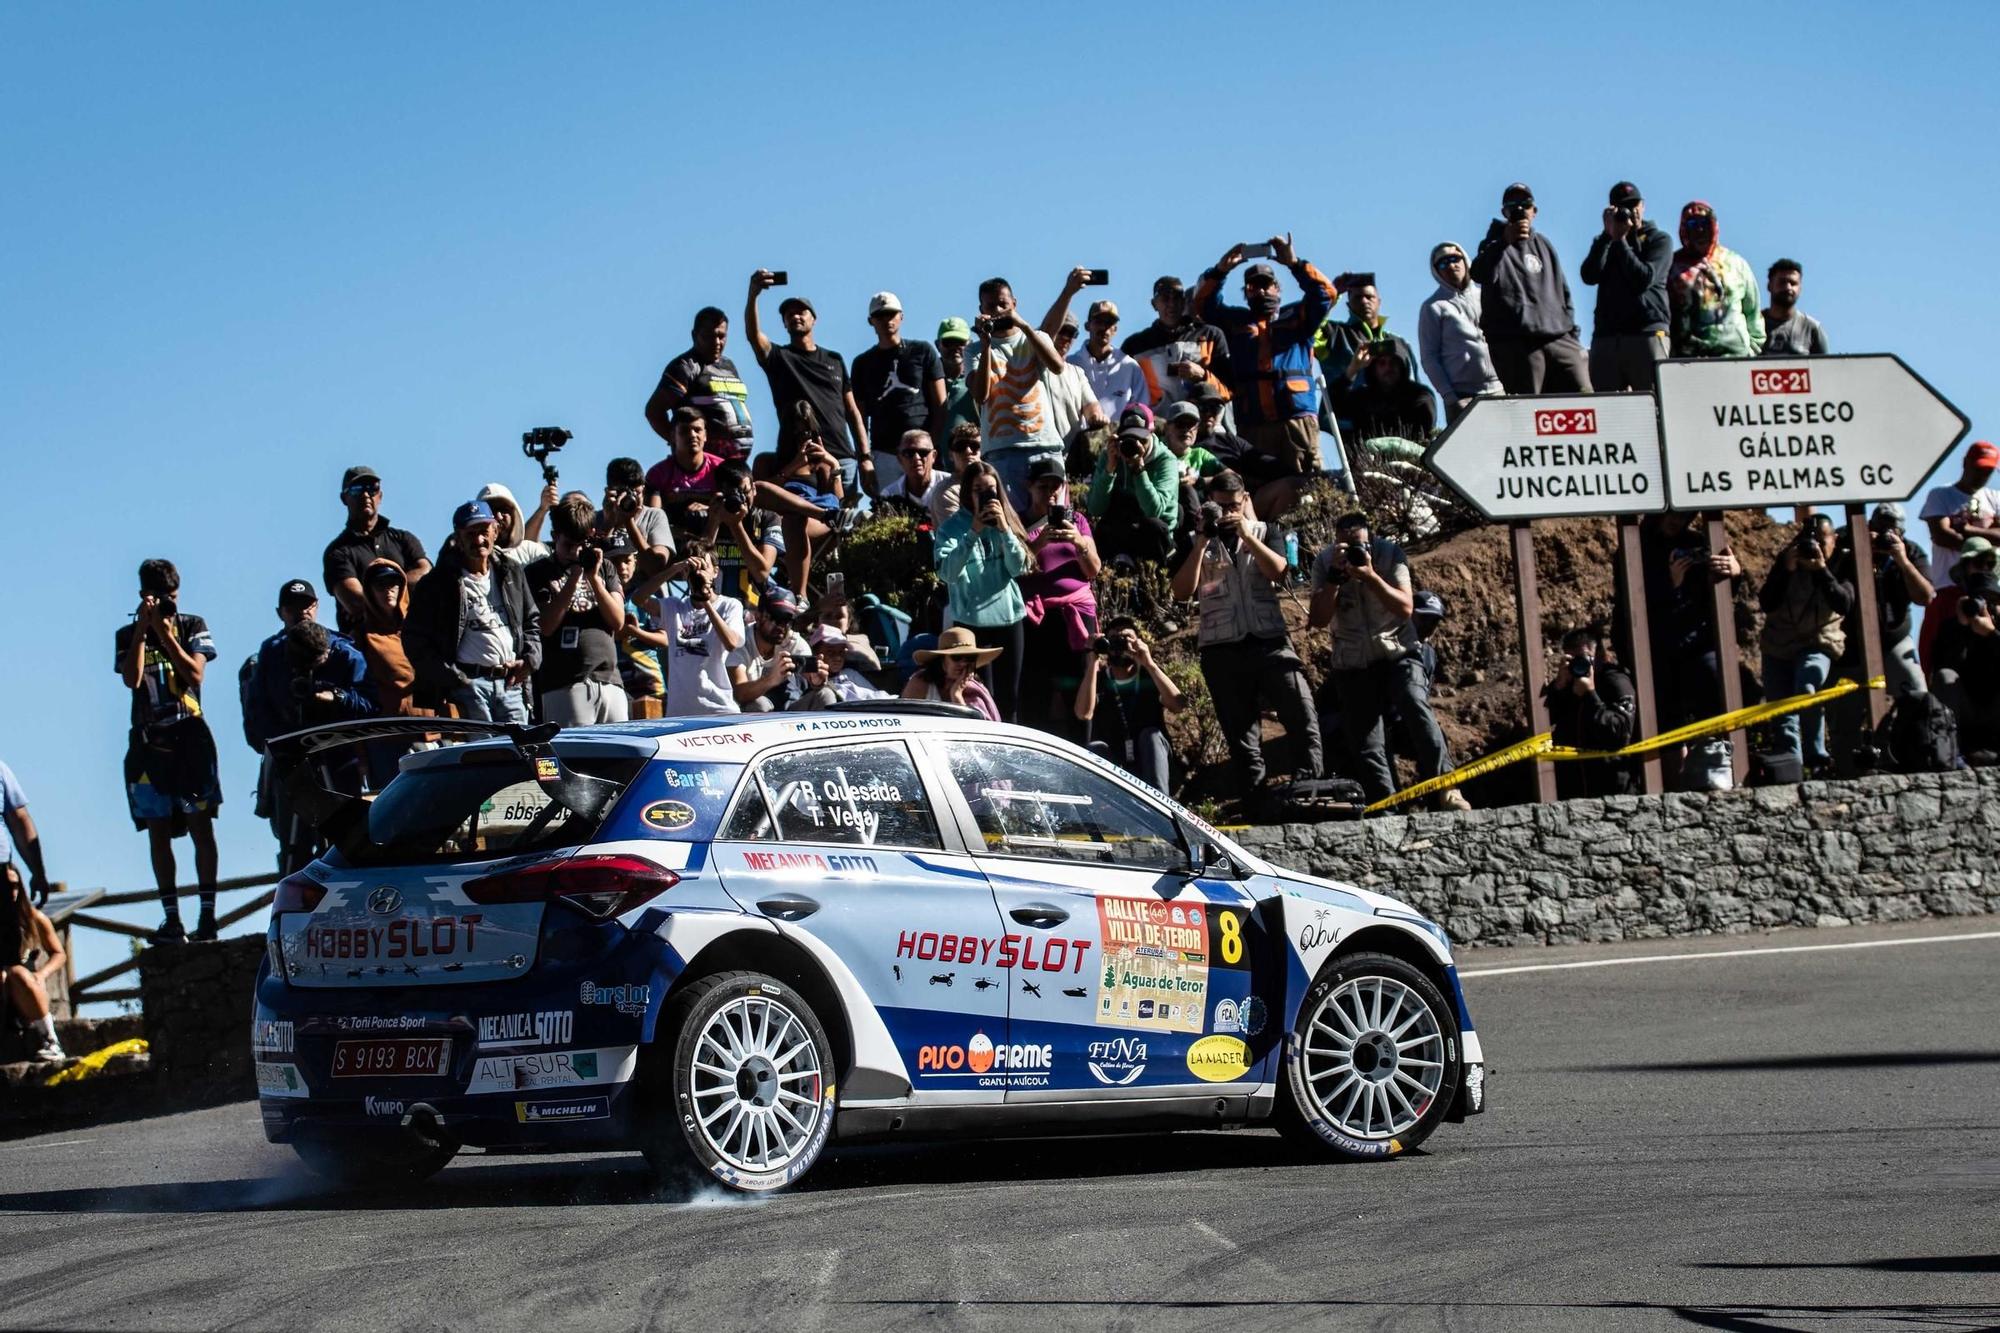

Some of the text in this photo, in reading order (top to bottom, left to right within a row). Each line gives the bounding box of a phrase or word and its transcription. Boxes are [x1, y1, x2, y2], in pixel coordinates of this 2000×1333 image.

[1753, 370, 1809, 394] GC-21
[1537, 411, 1595, 434] GC-21
[1713, 401, 1853, 427] VALLESECO
[1502, 442, 1638, 468] ARTENARA
[1739, 431, 1836, 458] GÁLDAR
[1497, 472, 1649, 499] JUNCALILLO
[1686, 464, 1894, 493] LAS PALMAS GC
[821, 720, 857, 730] TODO
[860, 718, 902, 729] MOTOR
[677, 734, 737, 748] VICTOR
[824, 780, 902, 802] Quesada
[807, 805, 874, 833] T. Vega
[743, 852, 829, 872] MECANICA
[1104, 898, 1150, 922] RALLYE
[1108, 920, 1201, 950] VILLA DE TEROR
[1219, 910, 1243, 964] 8
[1122, 971, 1204, 993] Aguas de Teror
[351, 1015, 426, 1030] Toñi Ponce Sport
[478, 1010, 573, 1046] MECANICA SOTO
[336, 1048, 347, 1070] S
[355, 1047, 396, 1069] 9193
[405, 1046, 438, 1069] BCK
[994, 1043, 1053, 1069] FIRME
[1088, 1037, 1148, 1062] FINA
[1191, 1052, 1249, 1065] LA MADERA
[978, 1077, 1013, 1087] GRANJA
[365, 1095, 404, 1117] KYMPO
[541, 1103, 597, 1116] MICHELIN
[791, 1113, 831, 1178] MICHELIN
[1316, 1122, 1378, 1153] MICHELIN
